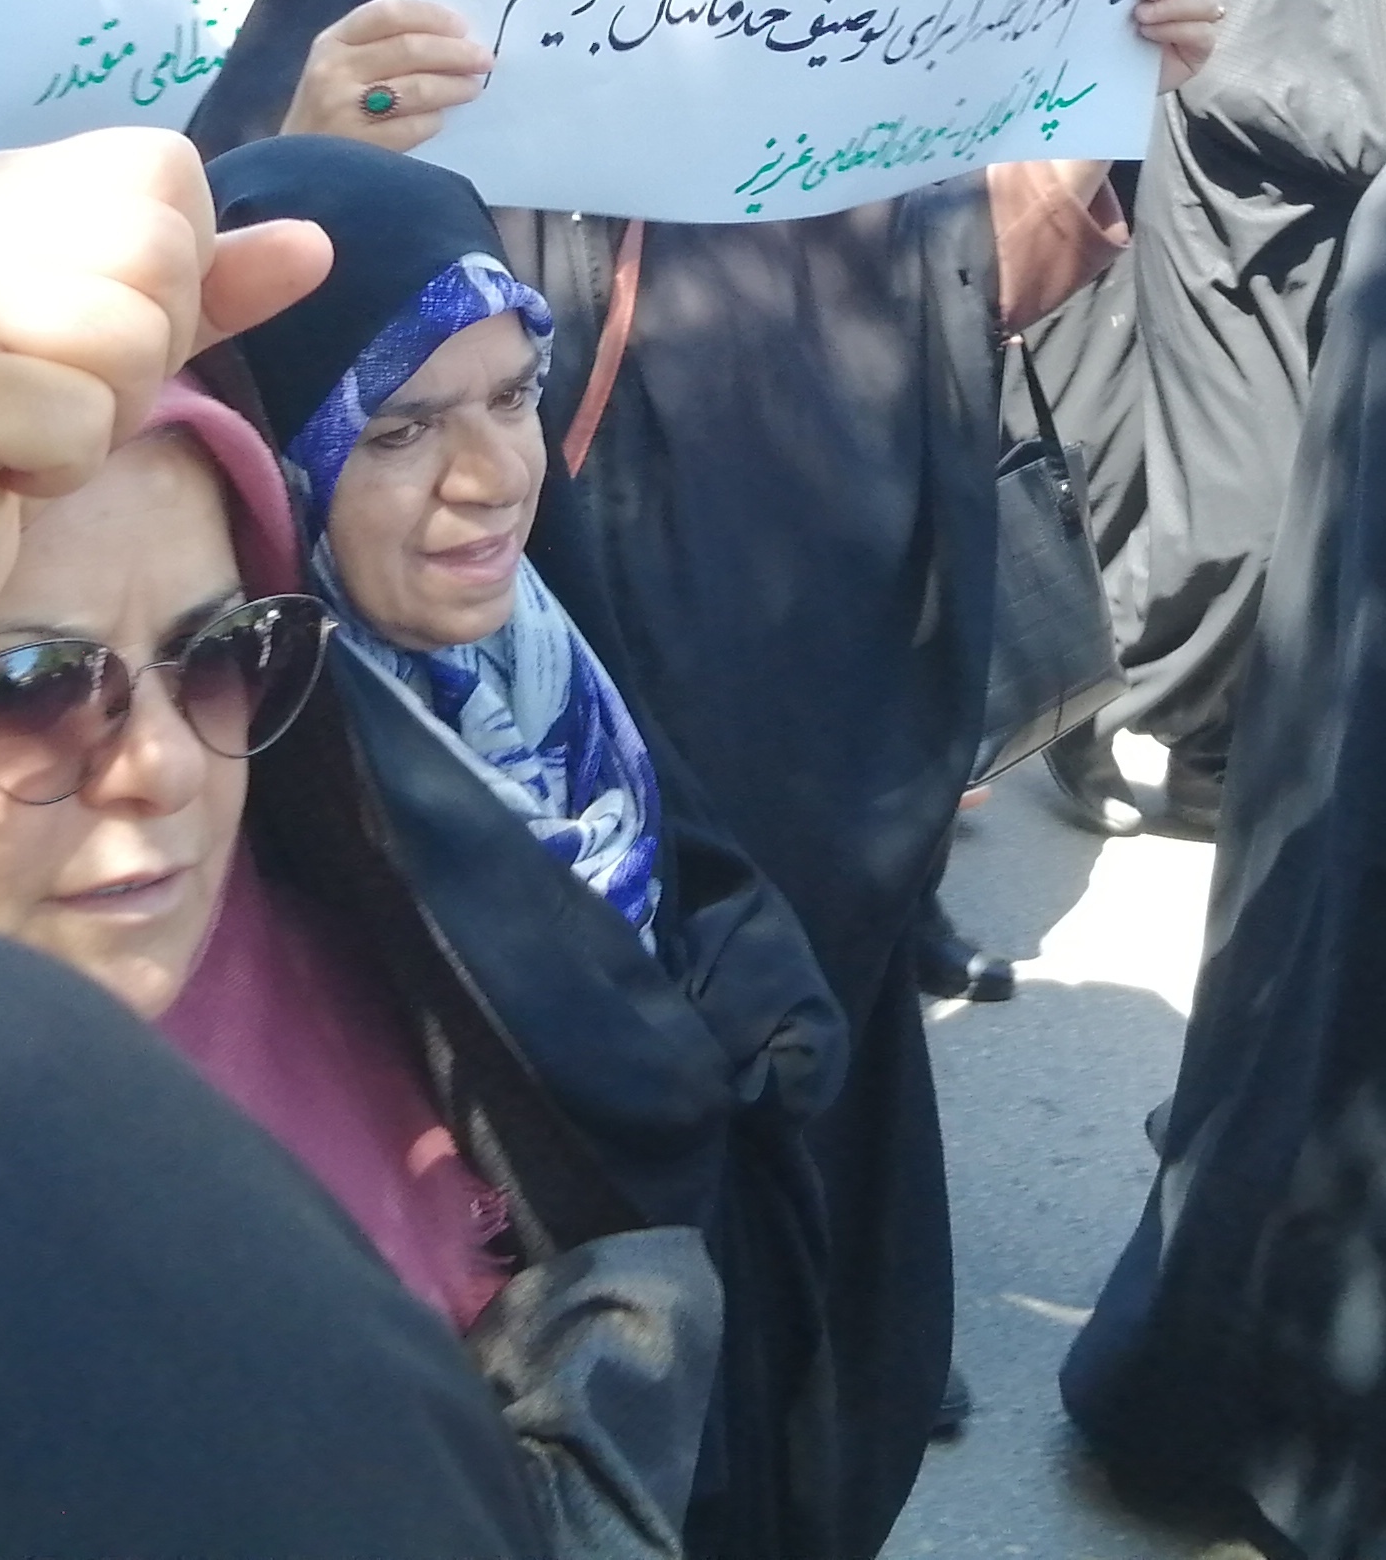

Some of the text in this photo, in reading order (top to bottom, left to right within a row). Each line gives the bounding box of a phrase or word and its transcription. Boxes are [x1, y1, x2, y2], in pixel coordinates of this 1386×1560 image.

[33, 18, 136, 106] مقتدر
[1034, 58, 1098, 141] سپاه
[734, 133, 815, 214] عزیز
